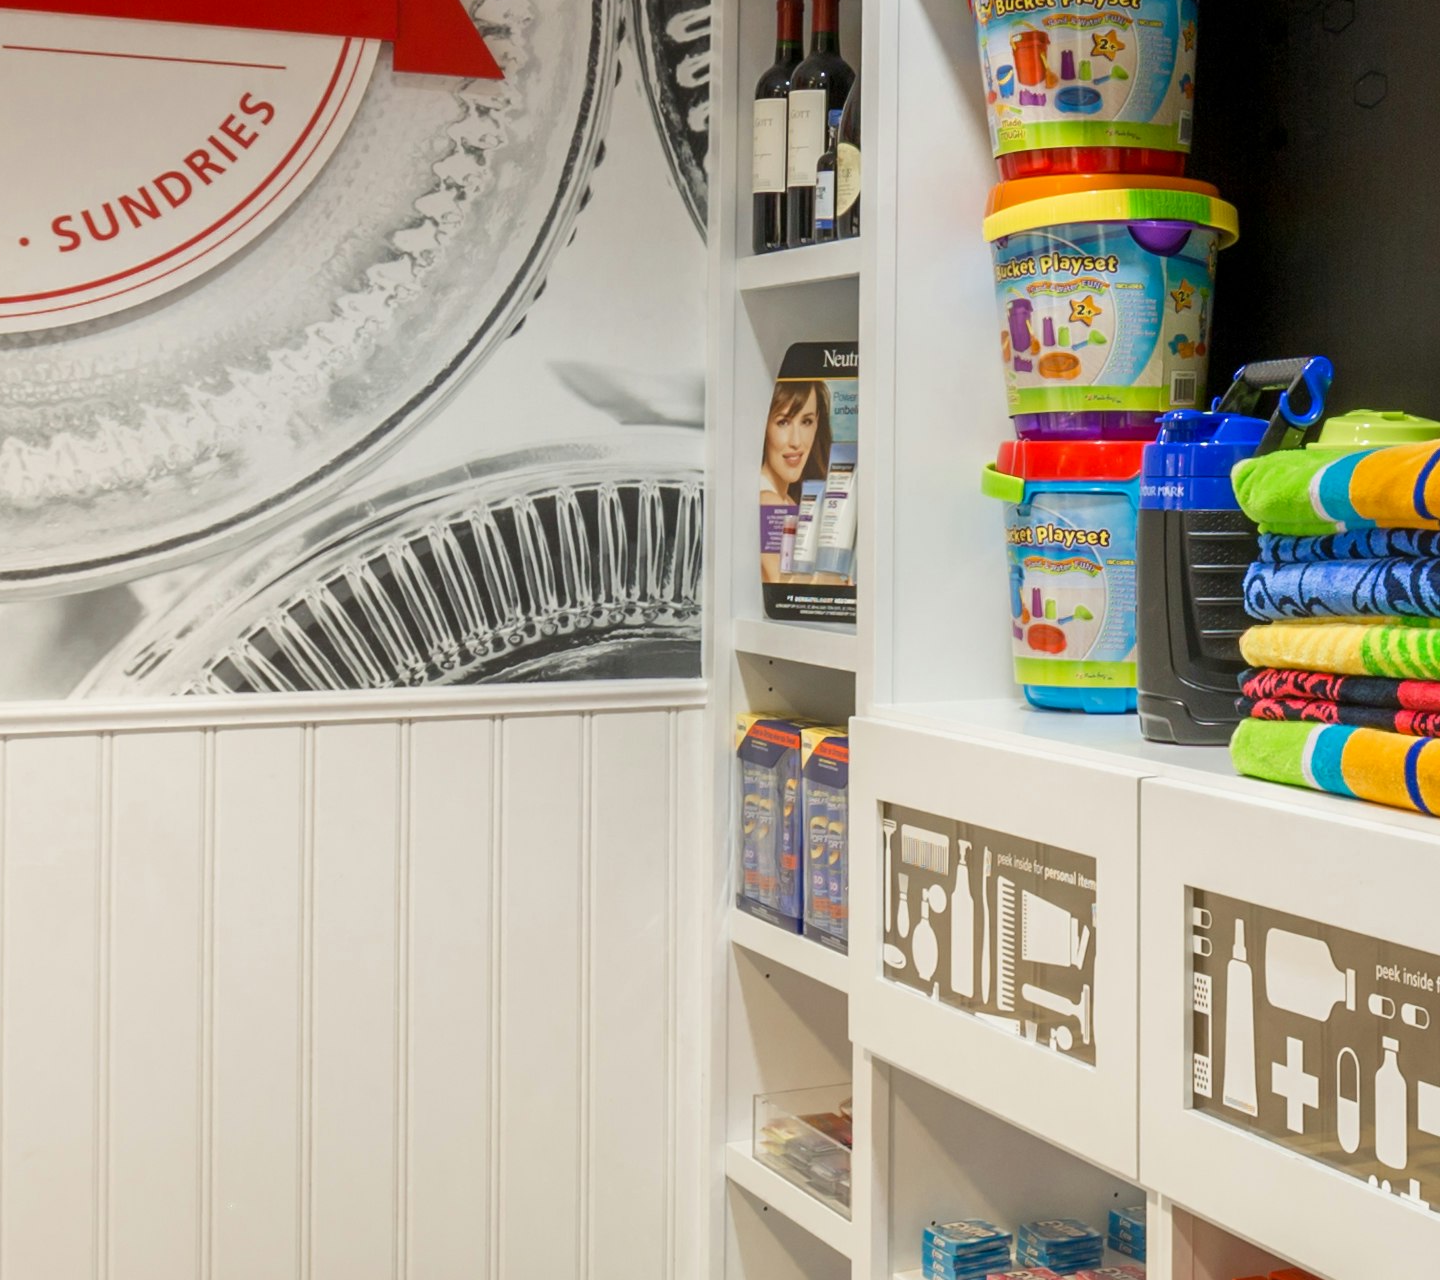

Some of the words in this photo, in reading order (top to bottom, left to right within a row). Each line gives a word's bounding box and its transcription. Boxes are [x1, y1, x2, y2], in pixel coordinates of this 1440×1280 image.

[51, 90, 277, 253] SUNDRIES
[995, 257, 1035, 281] Bucket
[1040, 252, 1119, 274] Playset
[1077, 304, 1092, 316] 2+
[823, 350, 858, 367] Neutr
[1036, 524, 1110, 548] Playset
[998, 854, 1012, 866] peek
[1045, 867, 1076, 885] personal
[1376, 965, 1400, 981] peek
[1403, 968, 1433, 991] inside
